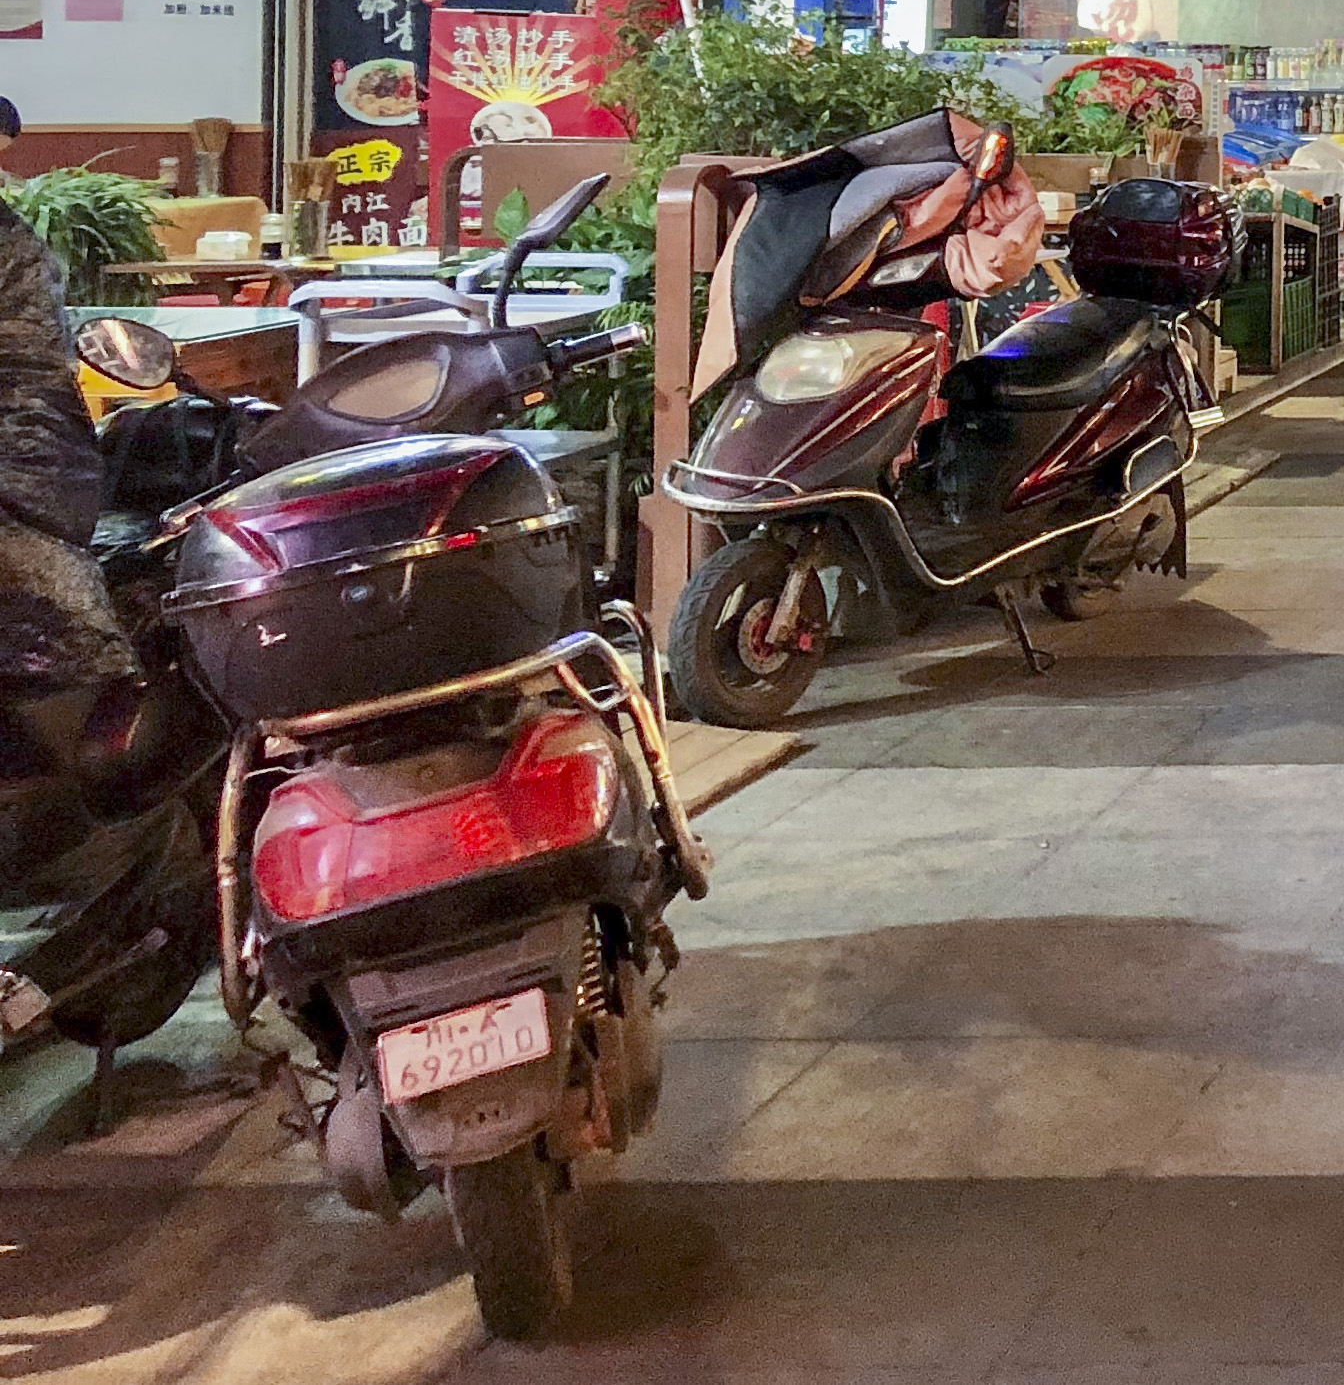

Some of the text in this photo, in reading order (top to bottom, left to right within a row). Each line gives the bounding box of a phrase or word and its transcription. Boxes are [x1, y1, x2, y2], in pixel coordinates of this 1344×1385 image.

[453, 26, 574, 49] 清汤抄手
[452, 49, 575, 71] 红汤抄手
[337, 150, 392, 175] 正宗
[341, 192, 391, 214] 内江
[327, 216, 428, 247] 牛肉面
[400, 1025, 534, 1091] 692010
